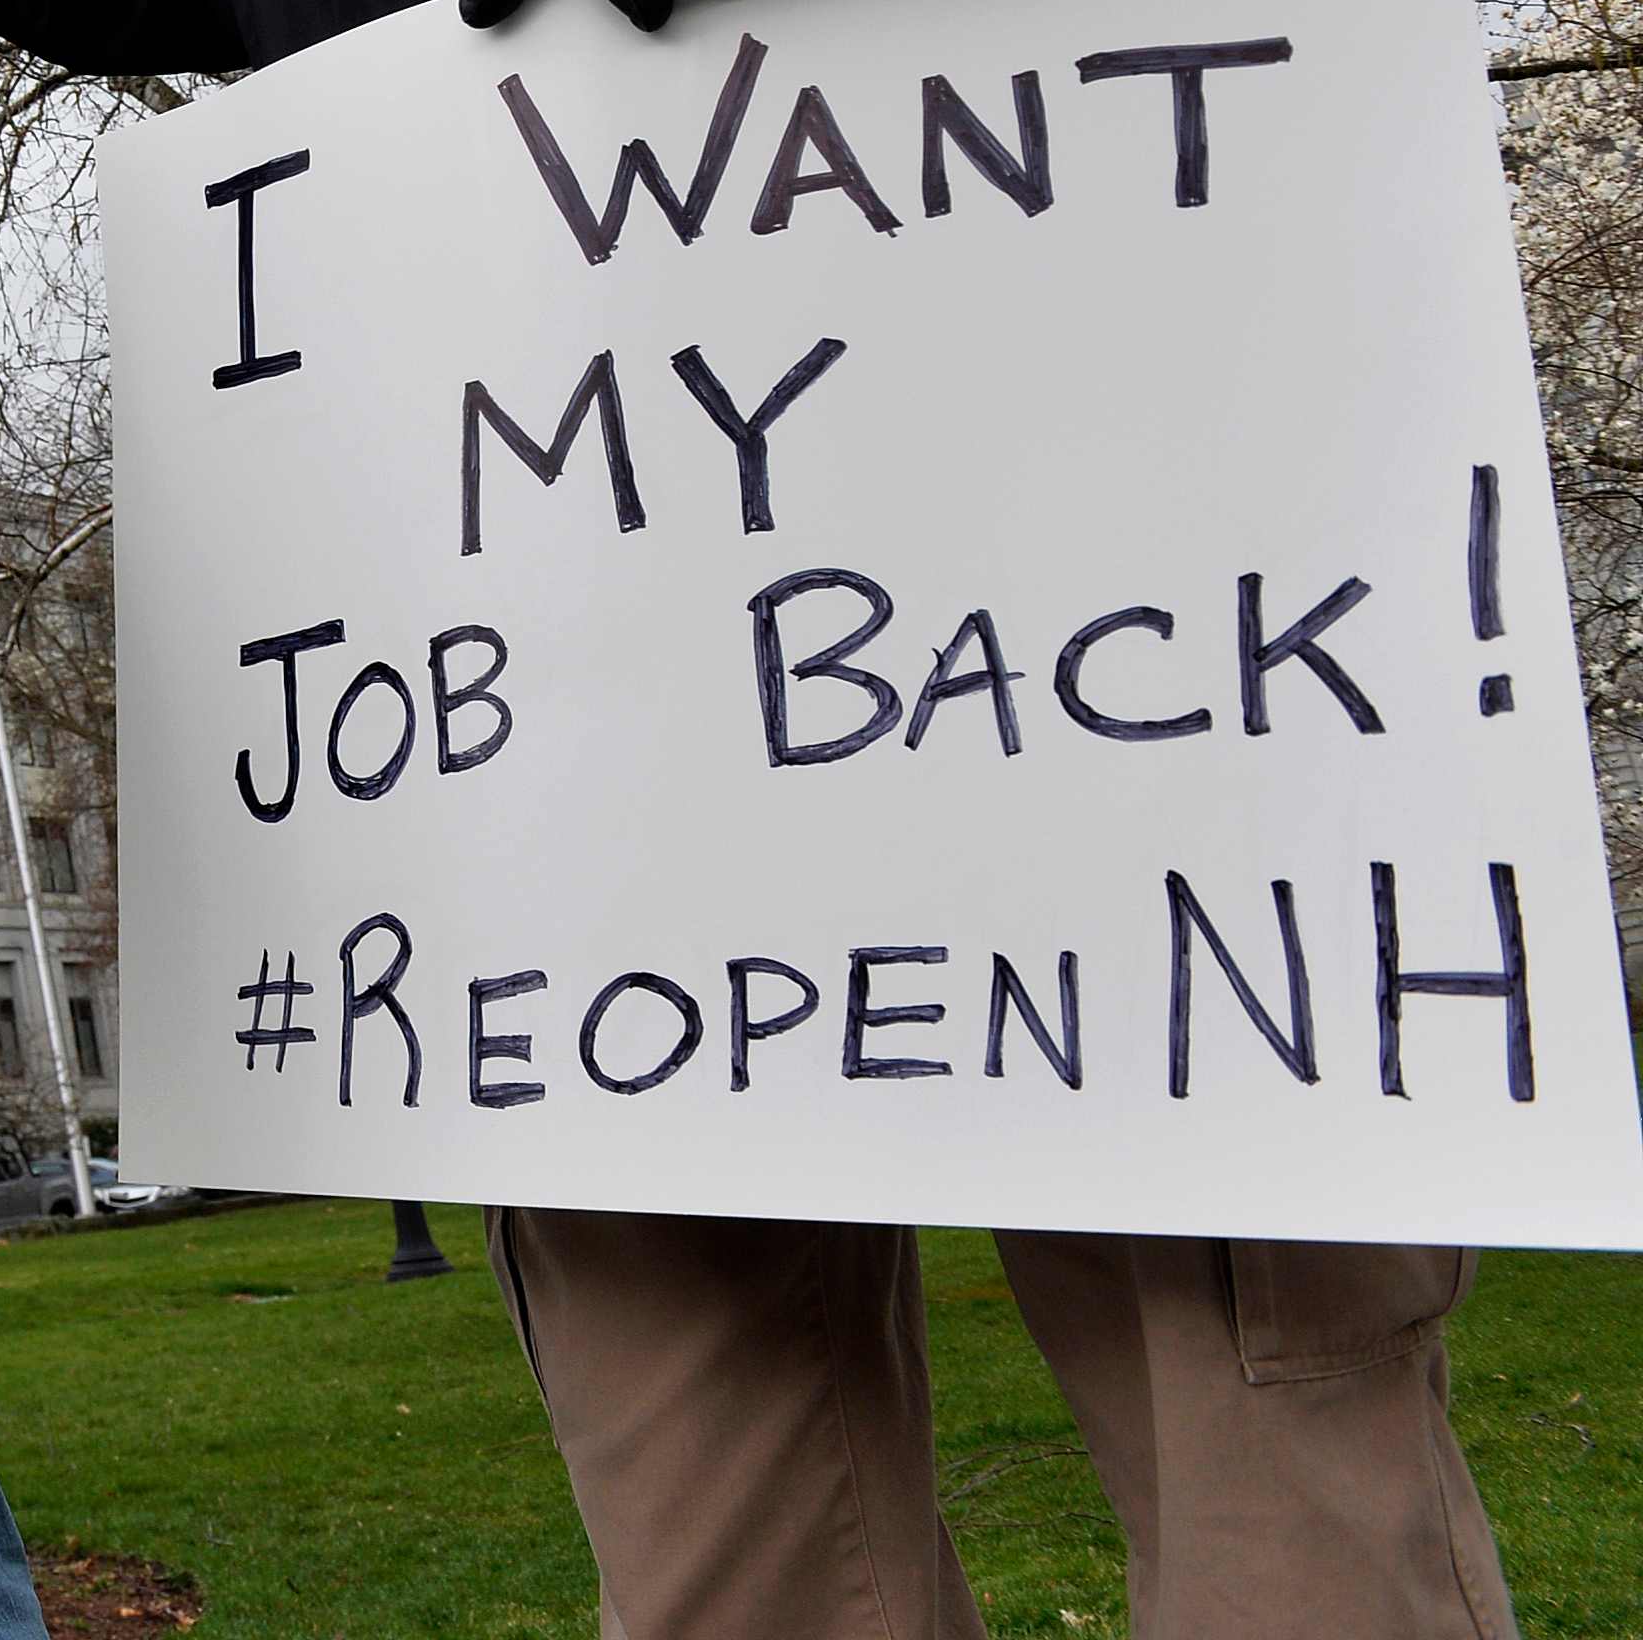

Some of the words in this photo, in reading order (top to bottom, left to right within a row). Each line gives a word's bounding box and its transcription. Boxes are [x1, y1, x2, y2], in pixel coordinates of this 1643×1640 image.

[205, 148, 310, 390] I
[496, 31, 1293, 266] WANT
[459, 338, 848, 558] MY
[234, 618, 514, 825] JOB
[234, 911, 1083, 1109] #REOPEN
[1164, 859, 1537, 1103] NH
